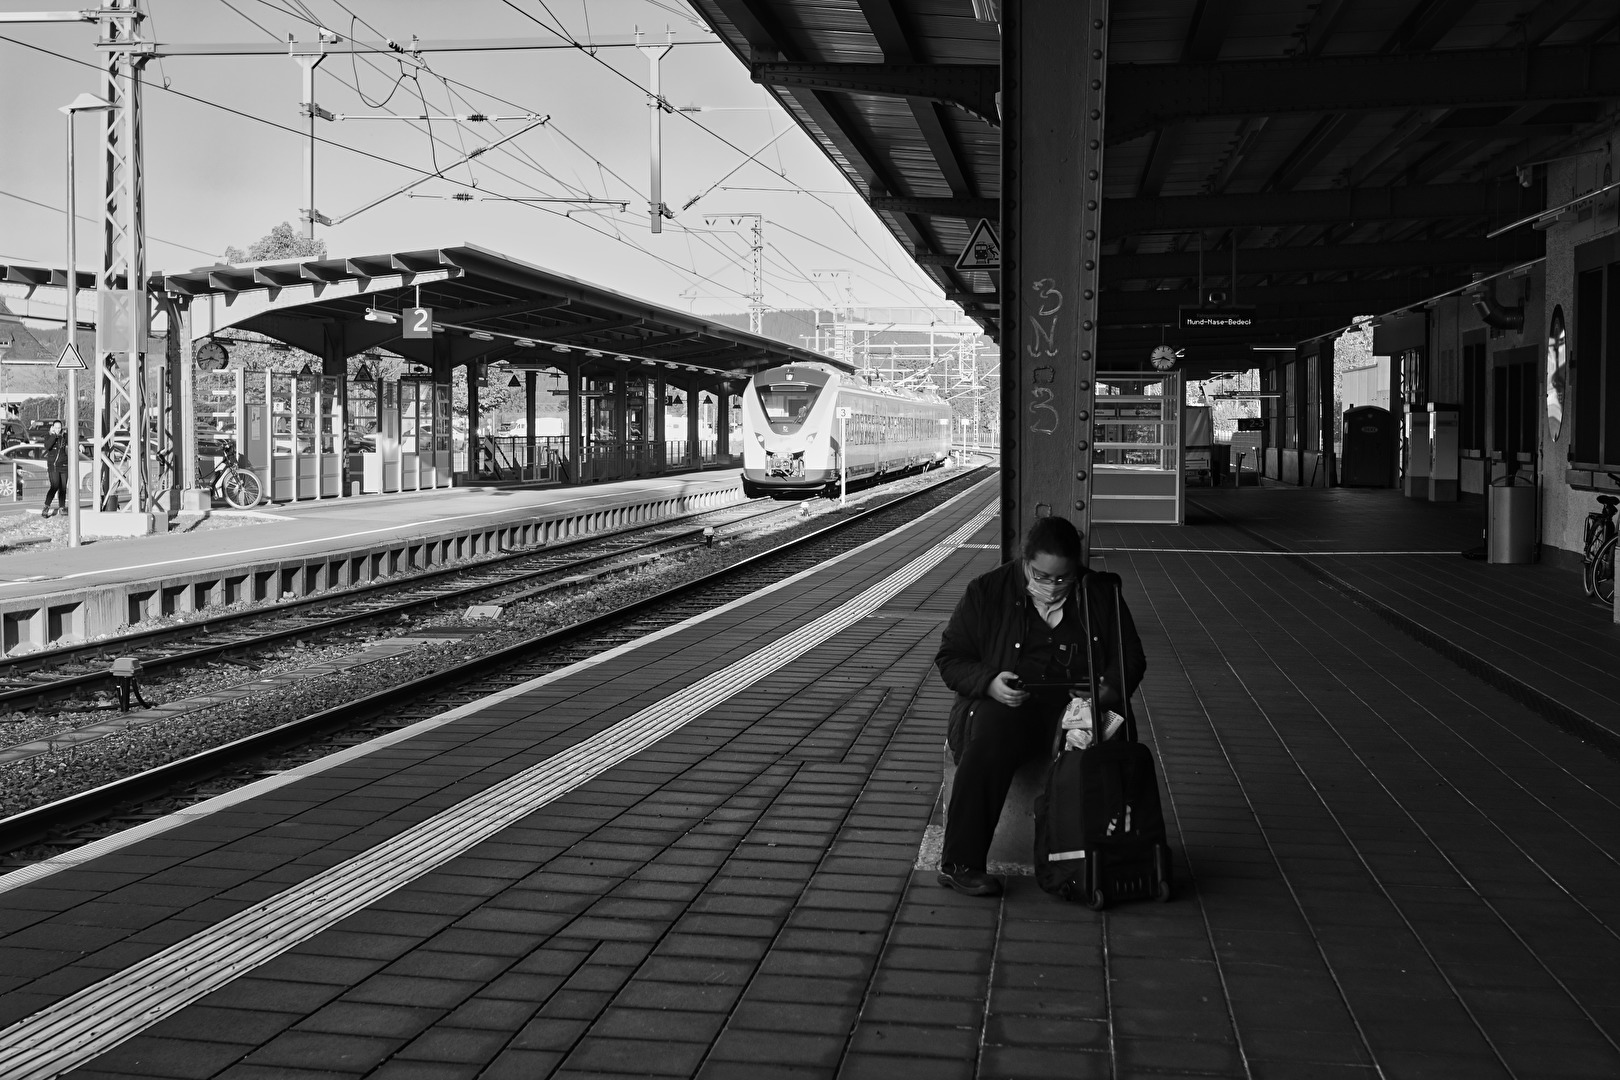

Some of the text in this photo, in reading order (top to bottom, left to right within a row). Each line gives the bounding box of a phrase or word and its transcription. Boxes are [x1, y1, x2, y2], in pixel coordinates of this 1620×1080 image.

[413, 309, 428, 332] 2
[840, 408, 847, 418] 3
[1249, 418, 1265, 428] 2-3
